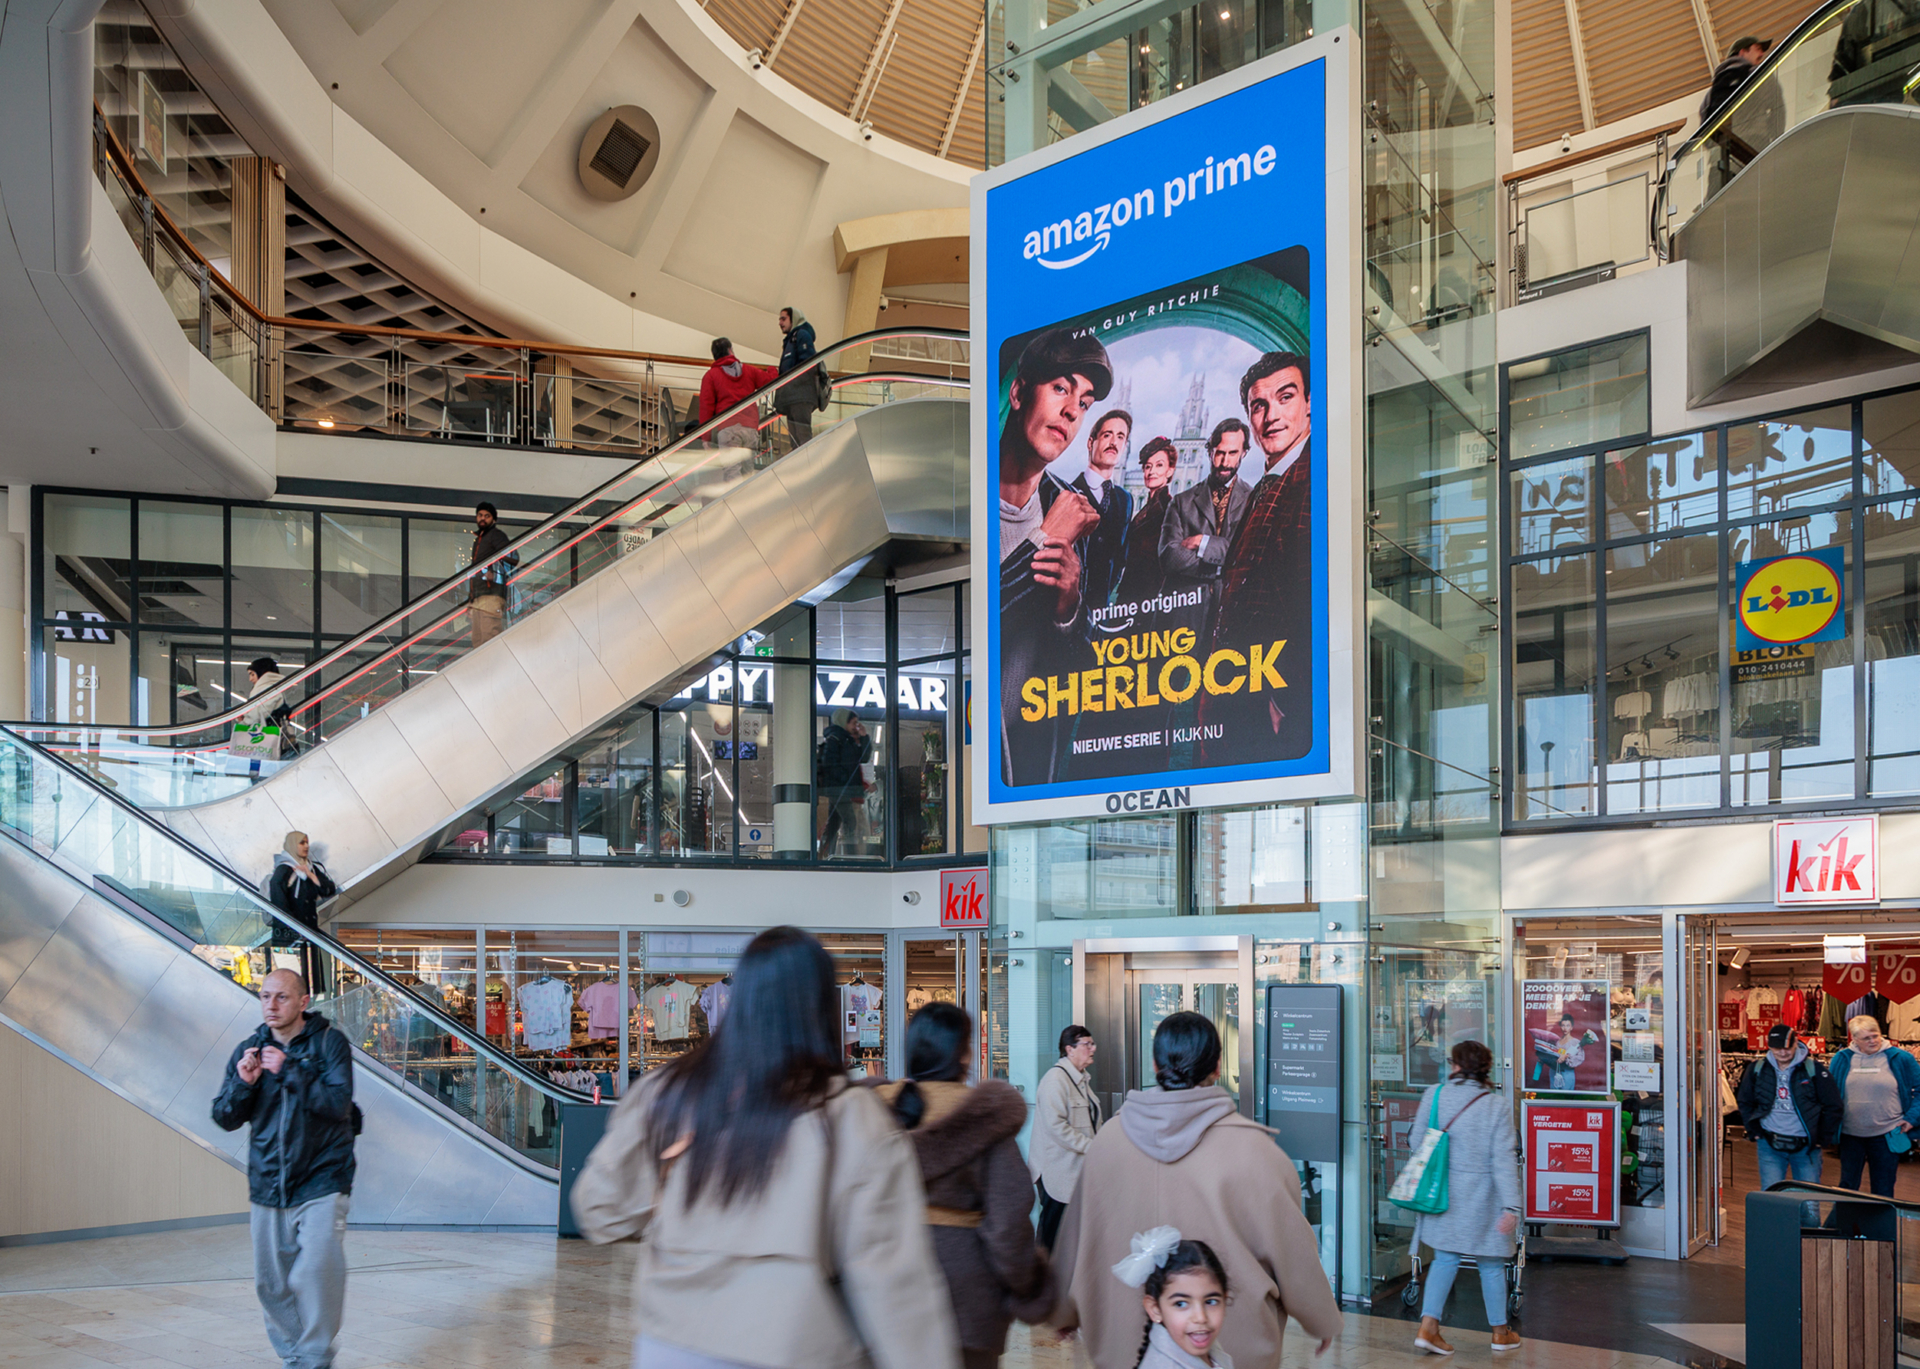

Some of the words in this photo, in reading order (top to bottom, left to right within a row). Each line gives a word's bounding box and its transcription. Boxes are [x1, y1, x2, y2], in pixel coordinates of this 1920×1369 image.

[1023, 187, 1154, 261] amazon
[1163, 143, 1277, 218] prime
[1072, 326, 1096, 341] VAN
[1103, 311, 1138, 332] GUY
[1147, 284, 1221, 317] RITCHIE
[1092, 600, 1138, 625] prime
[1141, 587, 1202, 619] original
[1091, 626, 1196, 666] YOUNG
[1738, 644, 1804, 662] BLOK
[1020, 639, 1288, 722] SHERLOCK
[1738, 668, 1805, 682] blokmakelaars.nl
[1072, 735, 1122, 755] NIEUWE
[1123, 731, 1161, 748] SERIE
[1173, 726, 1202, 743] KIJK
[1203, 724, 1224, 739] NU
[1105, 787, 1191, 814] OCEAN
[1525, 993, 1553, 1001] MEER
[1533, 1121, 1573, 1129] VERGETEN
